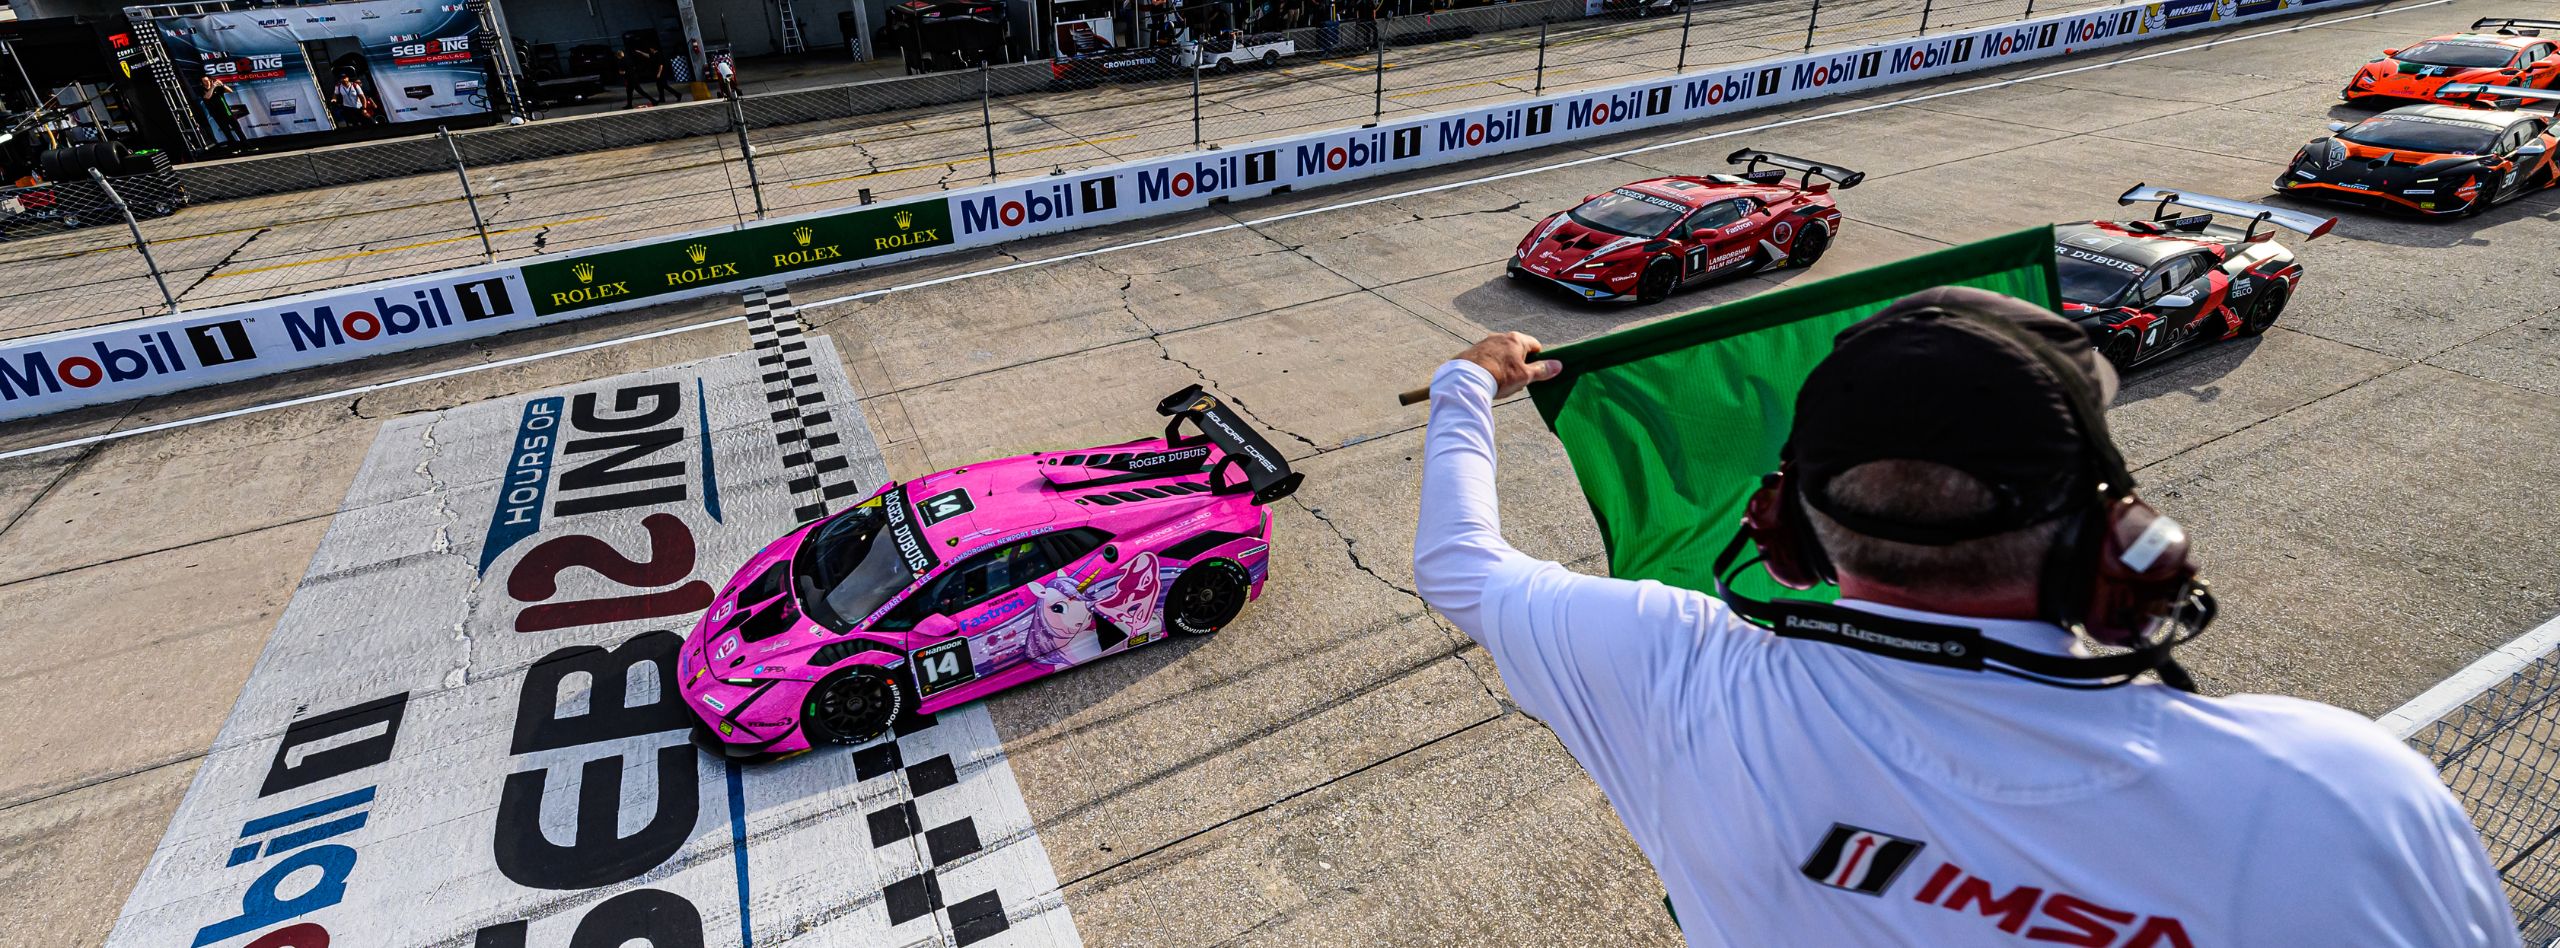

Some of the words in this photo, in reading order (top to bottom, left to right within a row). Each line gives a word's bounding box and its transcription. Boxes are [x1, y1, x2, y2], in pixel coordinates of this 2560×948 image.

[2169, 2, 2214, 17] MICHELIN
[1981, 26, 2039, 59] Mobil
[2064, 13, 2119, 45] Mobil
[1103, 57, 1157, 69] CROWDSTRIKE
[1792, 55, 1857, 91] Mobil
[1889, 40, 1952, 74] Mobil
[1684, 72, 1755, 110] Mobil
[1567, 91, 1643, 130] Mobil
[1439, 109, 1521, 152] Mobil
[1297, 131, 1386, 177] Mobil
[1137, 156, 1237, 204] Mobil
[2502, 171, 2516, 189] 30
[960, 183, 1073, 234] Mobil
[1614, 188, 1645, 200] ROGER
[1645, 196, 1686, 212] DUBUIS
[874, 228, 939, 251] ROLEX
[1725, 220, 1753, 236] Fastron
[772, 245, 842, 268] ROLEX
[1708, 262, 1725, 273] PALM
[1725, 254, 1746, 268] BEACH
[1709, 246, 1751, 265] LAMBORGHINI
[2070, 249, 2136, 272] DUBUIS
[666, 262, 739, 287] ROLEX
[551, 281, 630, 307] ROLEX
[2231, 287, 2253, 299] DELCO
[280, 288, 453, 352] Mobil
[2145, 328, 2157, 346] 4
[0, 331, 186, 401] Mobil
[1129, 452, 1166, 470] ROGER
[1168, 447, 1207, 463] DUBUIS
[1206, 410, 1245, 445] SQUADRA
[1244, 444, 1277, 473] CORSE
[504, 435, 549, 526] HOURS
[527, 402, 556, 432] OF
[885, 490, 905, 527] ROGER
[929, 494, 961, 518] 14
[1135, 527, 1173, 545] FLYING
[1174, 511, 1212, 529] LIZARD
[894, 524, 928, 571] DUBUIS
[948, 541, 995, 565] LAMBORGHINI
[997, 531, 1029, 545] NEWPORT
[1031, 526, 1054, 536] BEACH
[871, 596, 903, 622] STEWART
[919, 573, 932, 585] LEE
[960, 598, 1025, 632] Fastron
[923, 651, 960, 683] 14
[191, 785, 377, 948] bil
[1913, 862, 2196, 948] IMSA
